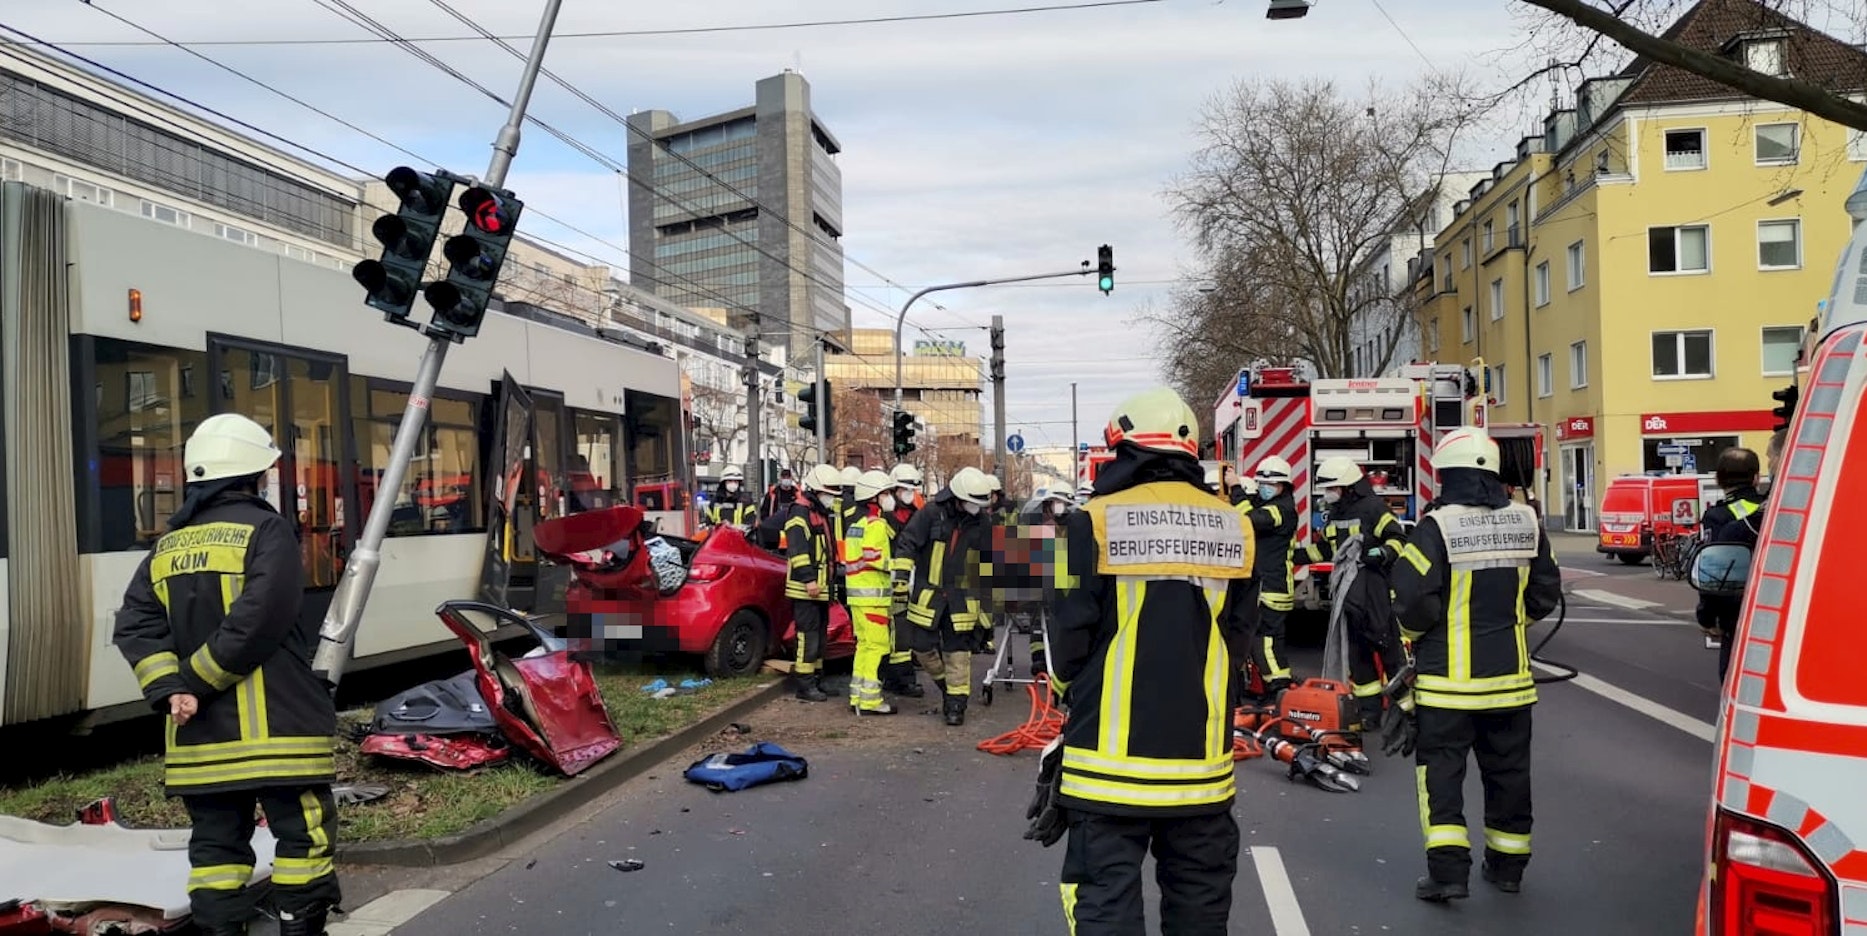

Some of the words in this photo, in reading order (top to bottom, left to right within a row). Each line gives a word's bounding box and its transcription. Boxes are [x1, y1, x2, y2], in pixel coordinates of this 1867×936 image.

[1571, 419, 1588, 430] DER
[1645, 416, 1667, 430] DER
[1127, 510, 1224, 529] EINSATZLEITER
[1459, 513, 1523, 528] EINSATZLEITER
[1451, 532, 1534, 548] BERUFSFEUERWEHR
[1109, 539, 1242, 559] BERUFSFEUERWEHR
